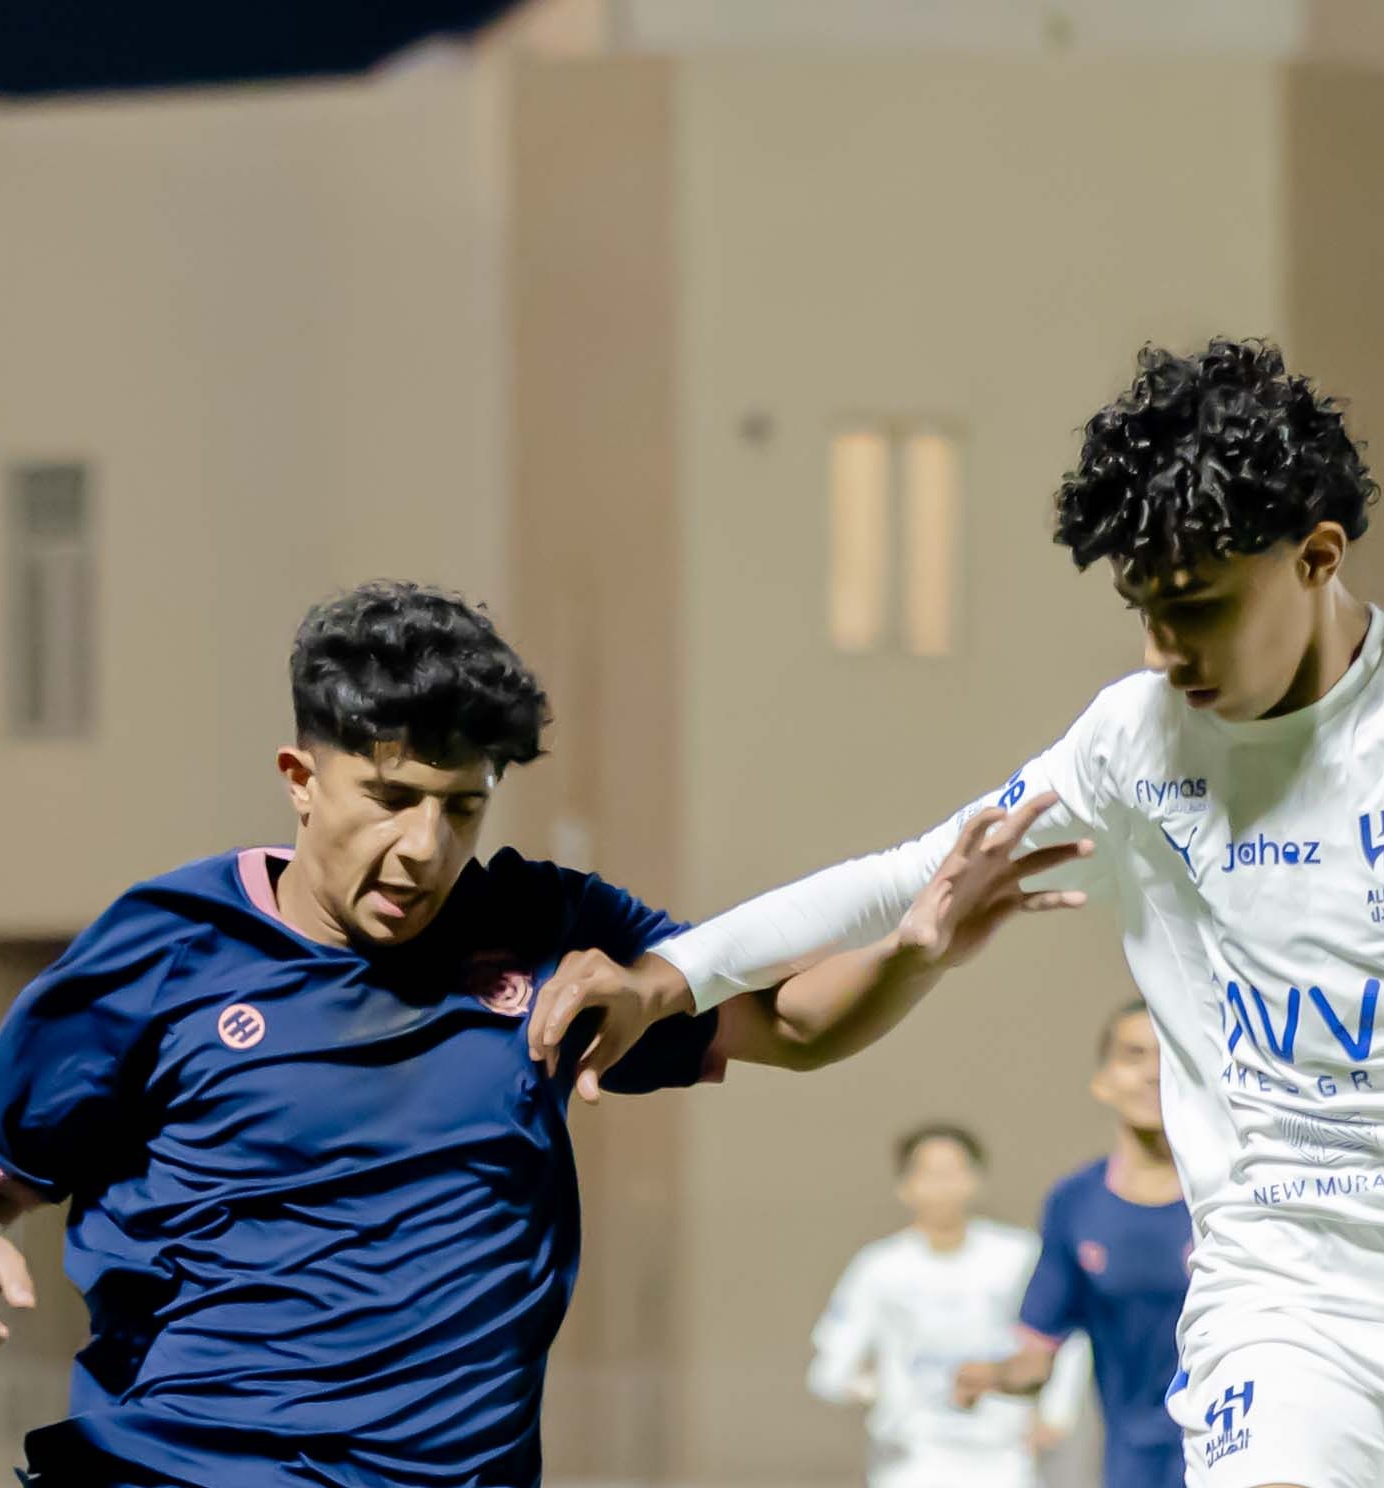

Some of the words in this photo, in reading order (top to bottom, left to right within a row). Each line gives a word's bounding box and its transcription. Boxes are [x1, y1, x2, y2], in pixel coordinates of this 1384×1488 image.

[1135, 777, 1208, 807] flynas
[1221, 832, 1322, 873] jahez
[1253, 1180, 1306, 1206] NEW
